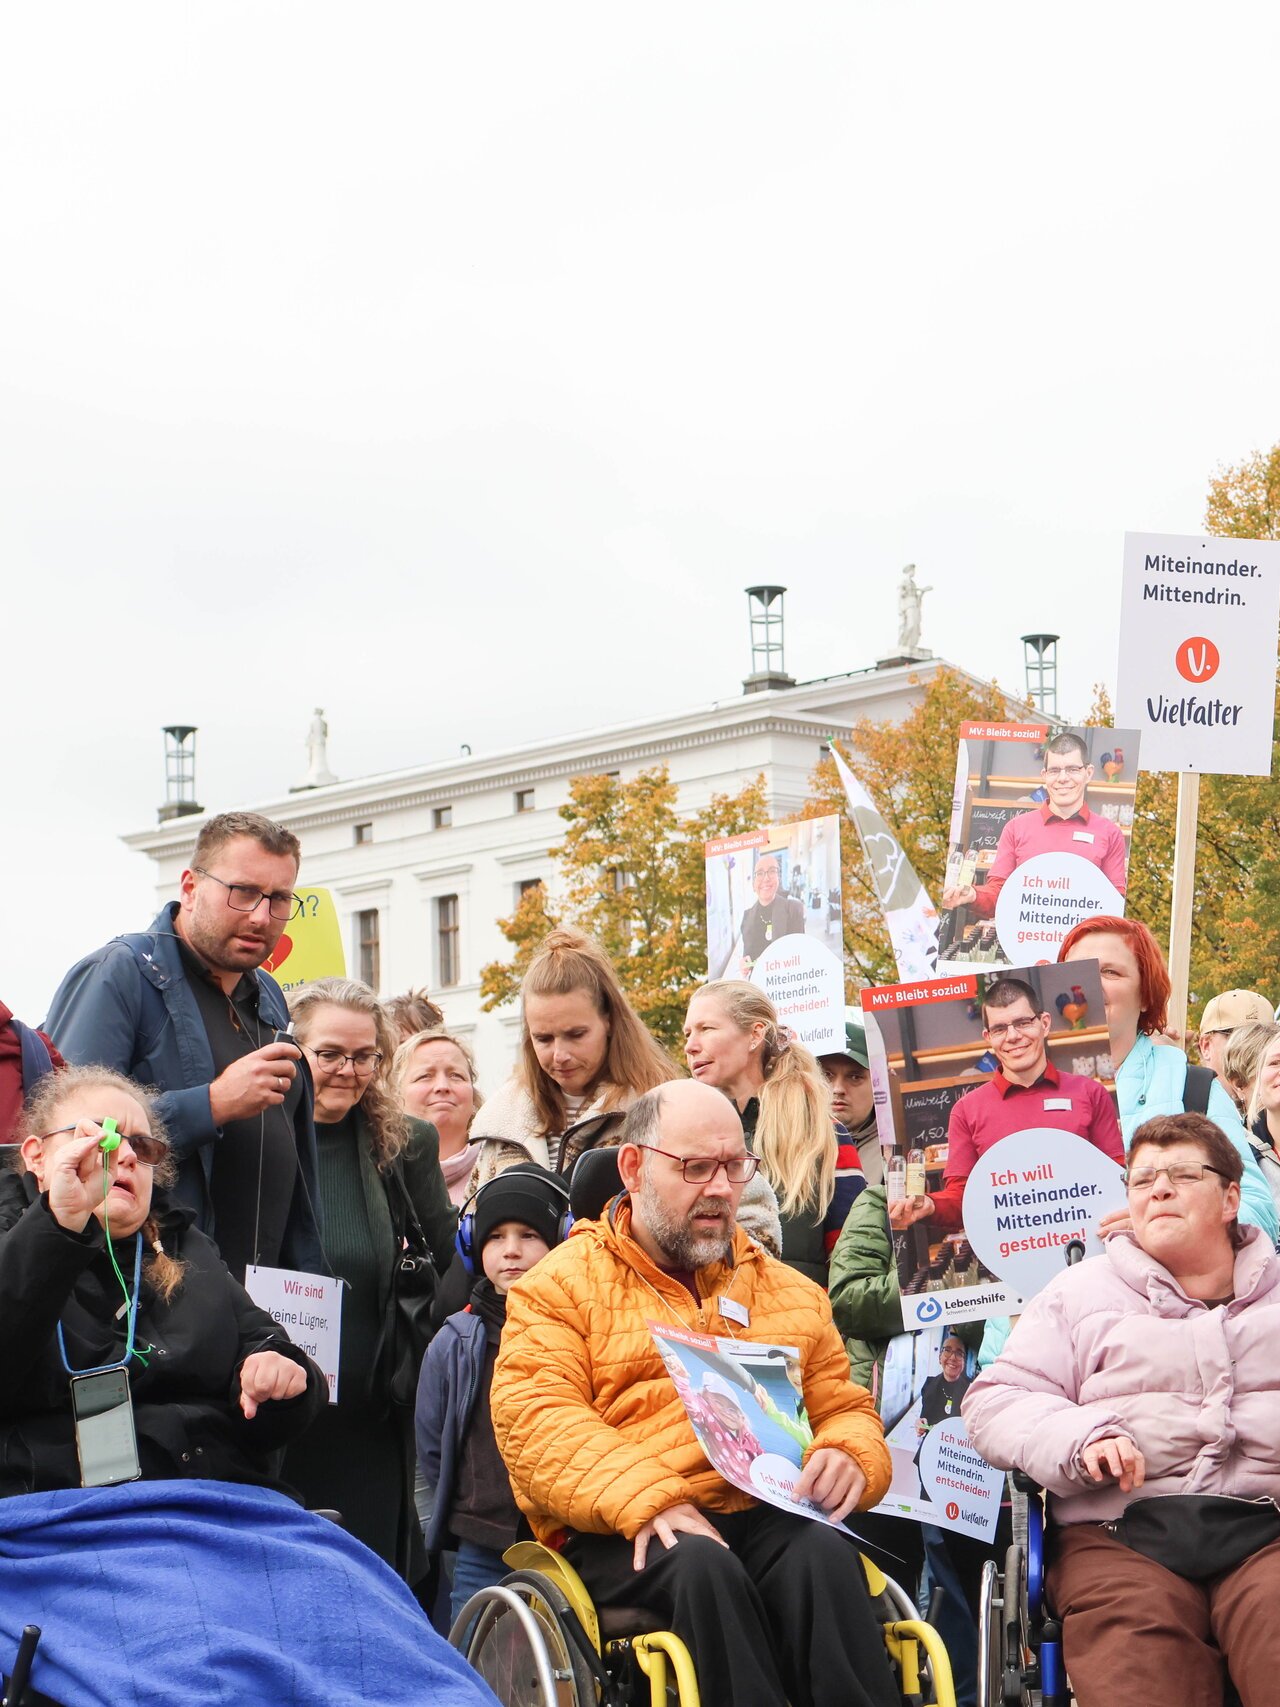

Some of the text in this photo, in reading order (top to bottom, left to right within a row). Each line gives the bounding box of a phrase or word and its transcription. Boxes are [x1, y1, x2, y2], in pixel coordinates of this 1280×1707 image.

[1144, 554, 1262, 578] Miteinander.
[1143, 583, 1246, 606] Mittendrin.
[1187, 643, 1211, 677] V.
[1146, 694, 1243, 727] Vielfalter
[968, 727, 1040, 739] MV: Bleibt sozial!
[1023, 875, 1070, 890] Ich will
[1020, 892, 1103, 910] Miteinander.
[765, 954, 801, 972] Ich will
[766, 967, 828, 987] Miteinander.
[767, 984, 821, 1001] Mittendrin.
[872, 982, 968, 1005] MV: Bleibt sozial!
[800, 1027, 834, 1043] Vielfalter
[990, 1163, 1054, 1187] Ich will
[993, 1182, 1102, 1209] Miteinander.
[996, 1205, 1092, 1232] Mittendrin.
[284, 1279, 324, 1300] Wir sind
[944, 1292, 1006, 1310] Lebenshilfe
[268, 1307, 329, 1332] keine Lügner,
[940, 1431, 955, 1444] Ich
[939, 1445, 993, 1471] Miteinander.
[760, 1471, 777, 1487] Ich
[937, 1459, 985, 1483] Mittendrin.
[935, 1475, 991, 1499] entscheiden!
[961, 1509, 989, 1528] Vielfalter
